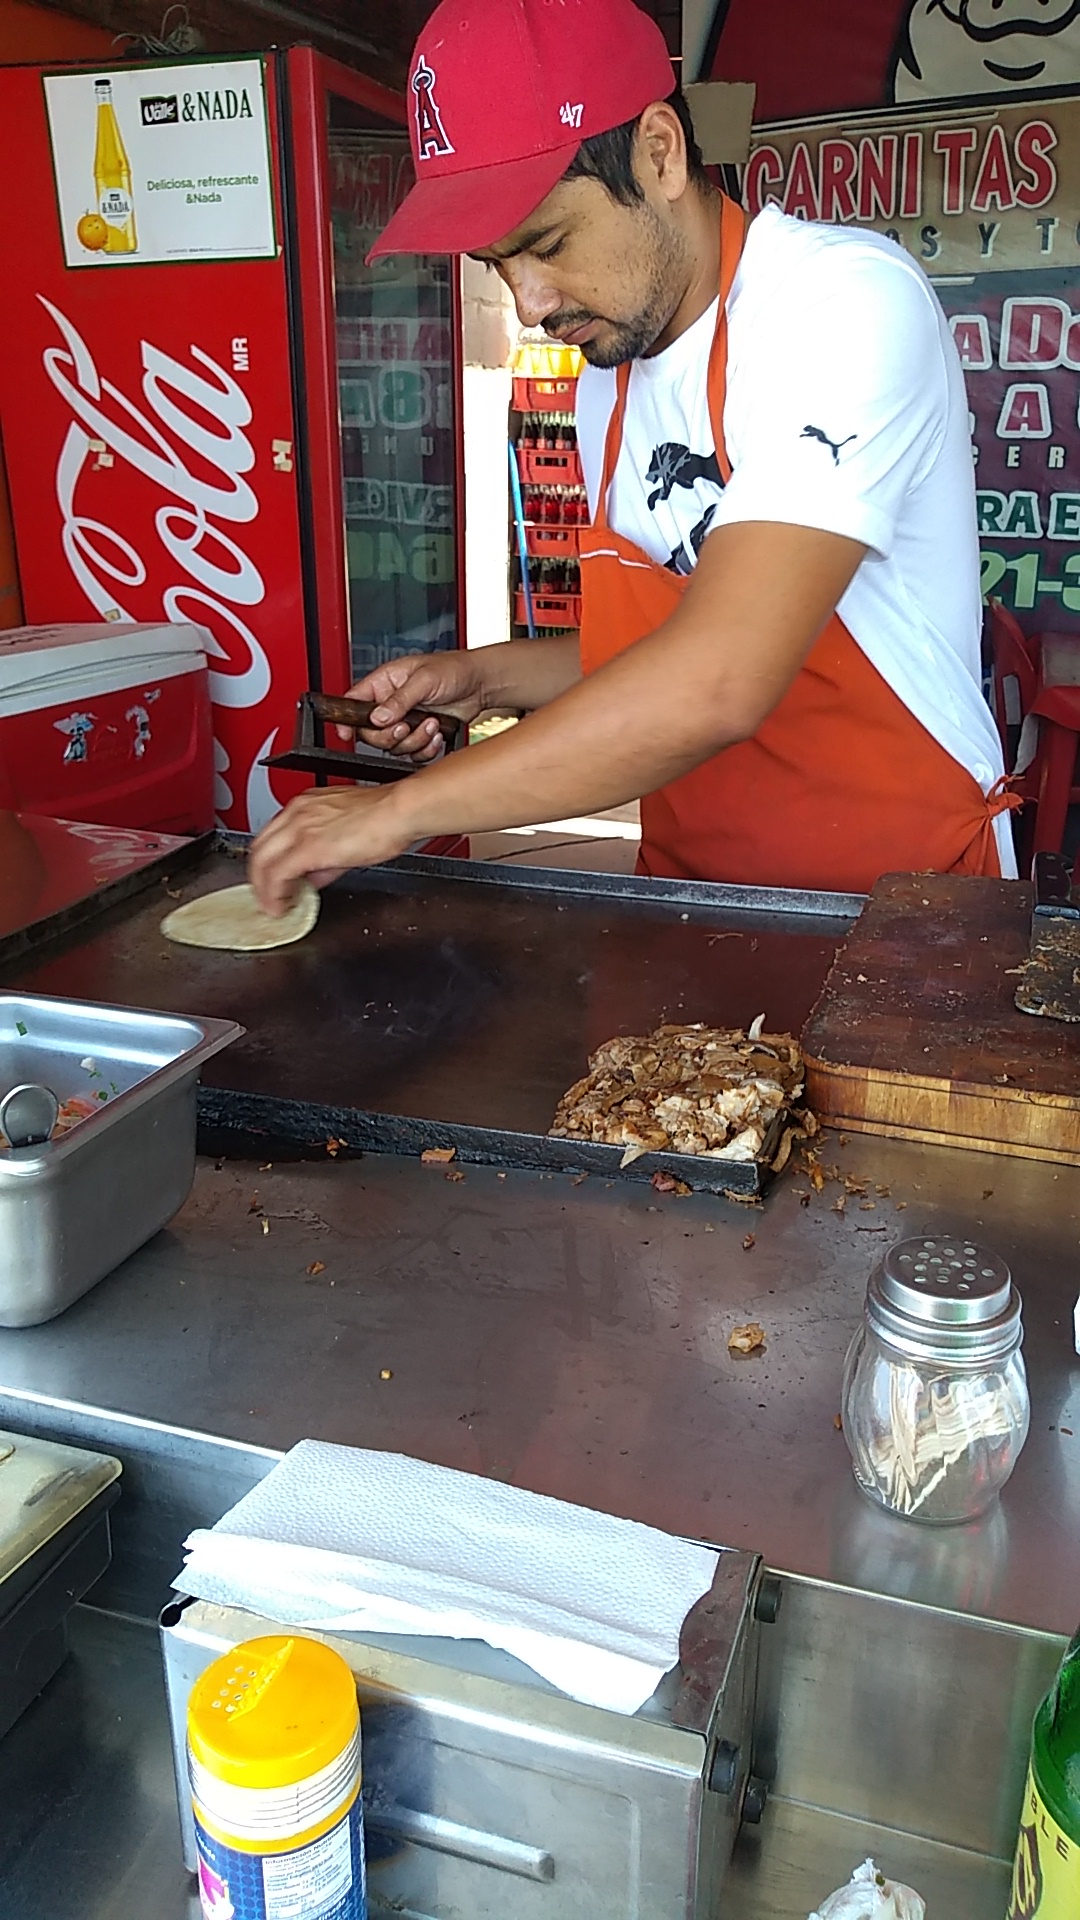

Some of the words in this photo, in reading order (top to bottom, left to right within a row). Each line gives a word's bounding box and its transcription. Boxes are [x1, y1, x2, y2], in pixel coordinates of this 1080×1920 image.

[147, 179, 195, 191] Deliciosa,
[197, 174, 259, 188] refrescante
[743, 120, 1058, 223] CARNITAS
[231, 337, 249, 371] MR
